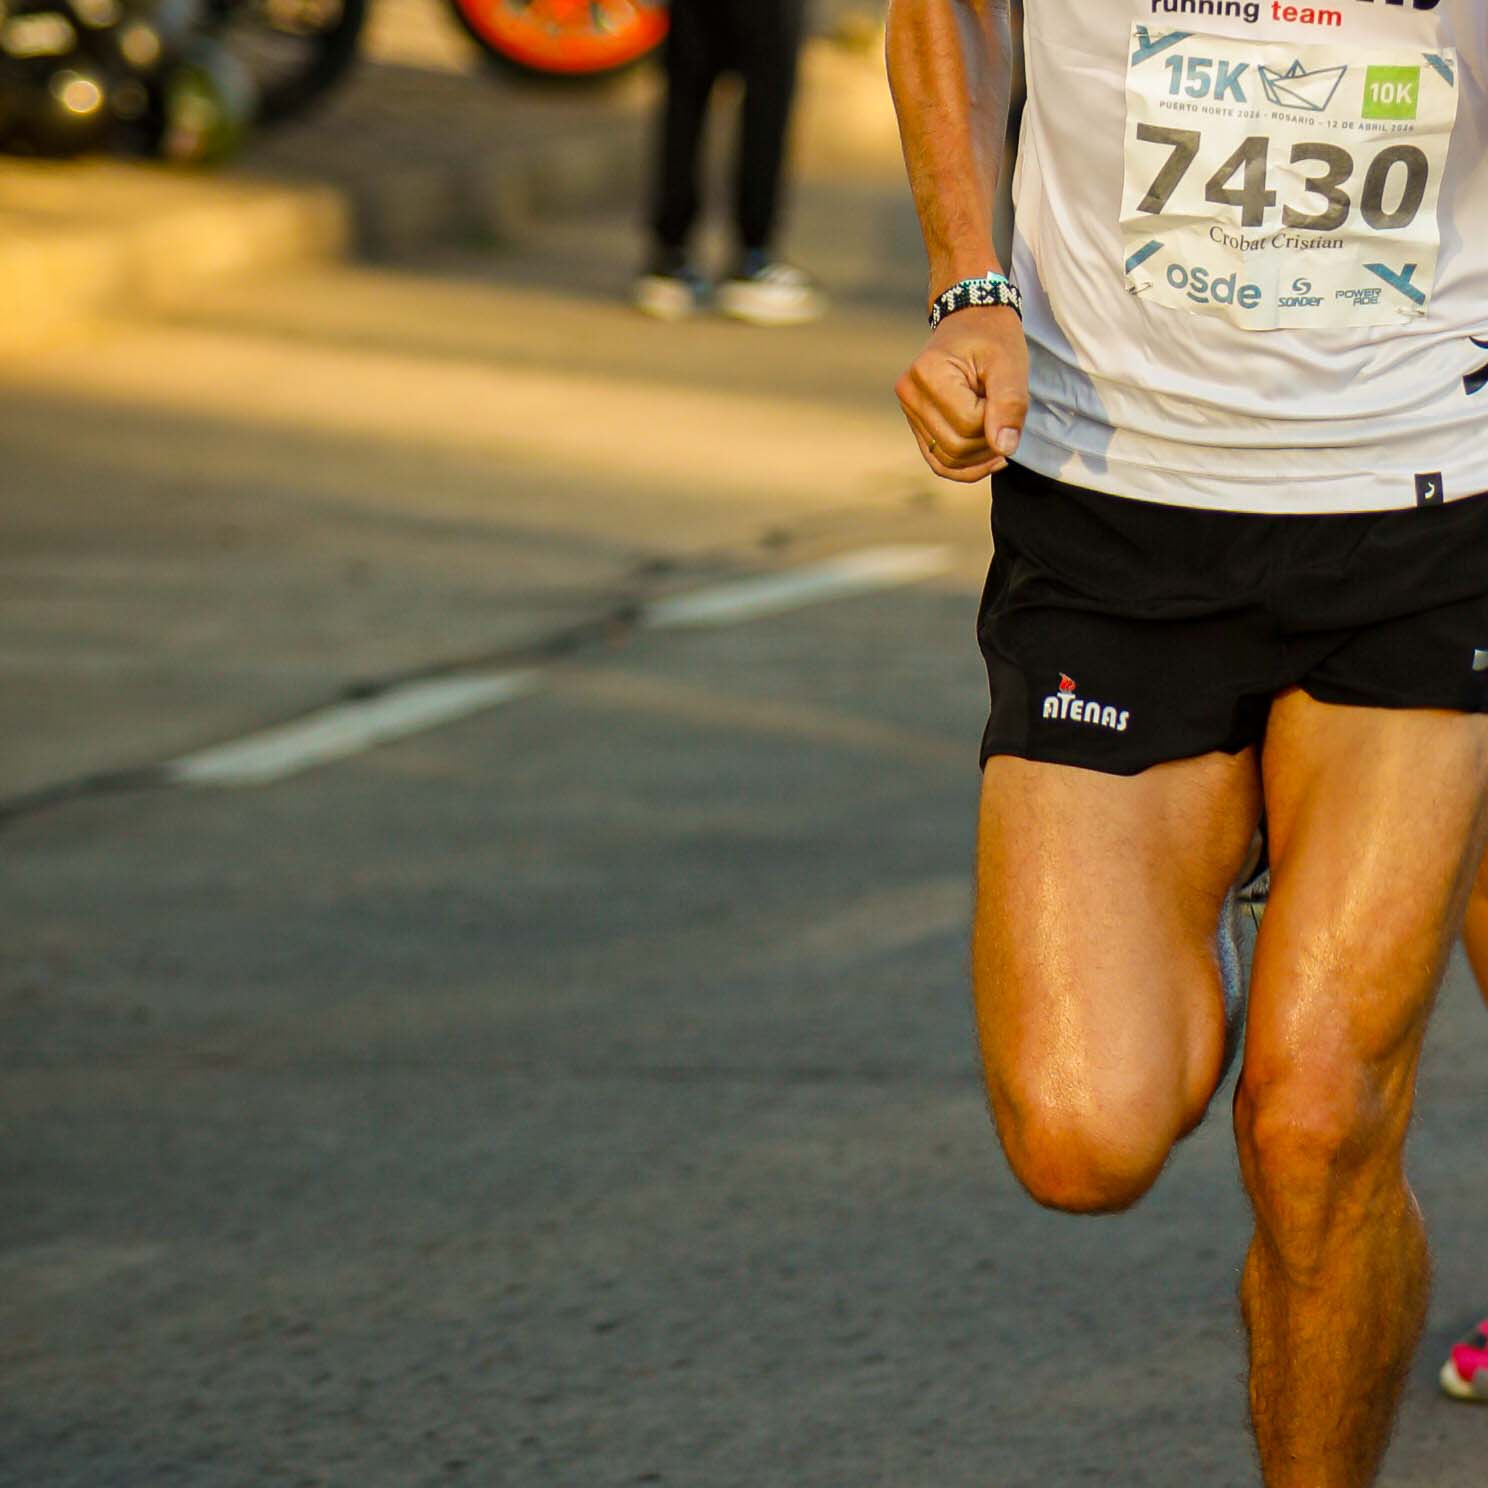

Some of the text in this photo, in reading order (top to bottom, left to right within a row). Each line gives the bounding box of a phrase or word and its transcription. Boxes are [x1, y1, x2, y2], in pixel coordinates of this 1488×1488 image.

[1271, 0, 1343, 28] team
[1165, 54, 1250, 104] 15K
[1369, 82, 1413, 105] 10K
[1159, 100, 1198, 113] PUERTO
[1201, 106, 1233, 118] NORTE
[1271, 112, 1315, 126] ROSARIO
[1327, 120, 1338, 129] 12
[1342, 121, 1354, 130] DE
[1358, 122, 1388, 133] ABRIL
[1136, 122, 1429, 232] 7430
[1209, 225, 1344, 252] Crobat Cristian
[1166, 263, 1262, 310] osde
[1335, 288, 1382, 299] POWER
[1353, 296, 1379, 307] ADE
[1042, 691, 1130, 731] ATENAS
